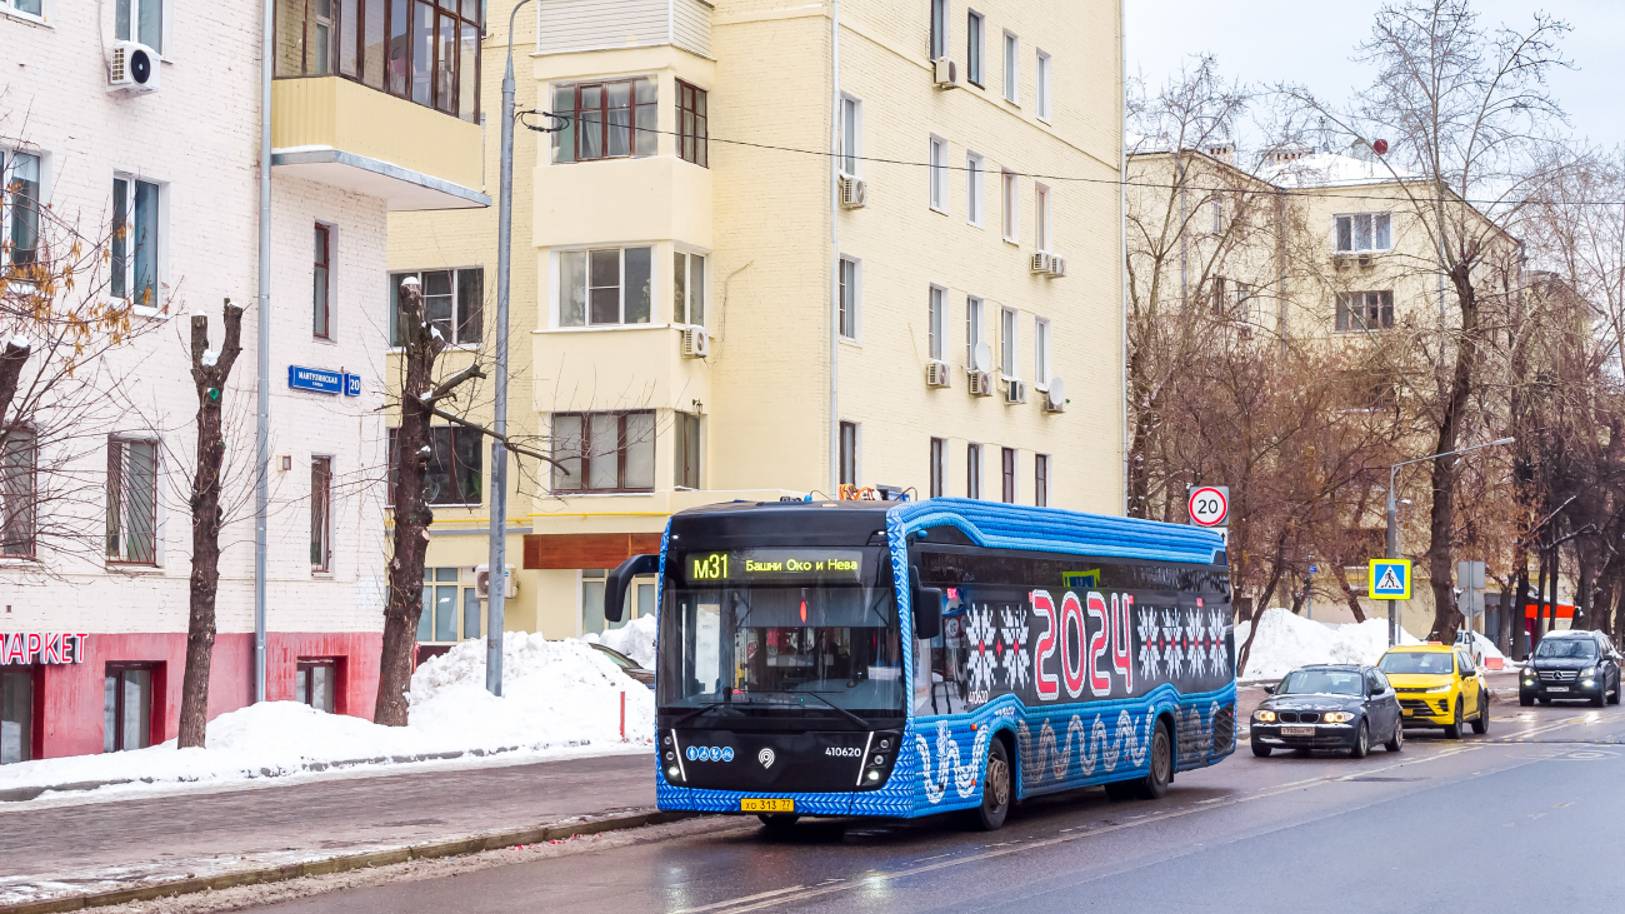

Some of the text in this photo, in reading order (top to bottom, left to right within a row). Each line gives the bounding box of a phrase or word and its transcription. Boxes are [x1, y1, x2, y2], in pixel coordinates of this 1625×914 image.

[350, 379, 360, 391] 20
[1198, 499, 1218, 514] 20
[694, 554, 728, 579] М31
[746, 559, 858, 572] Башни Око и Нева
[0, 632, 89, 665] АРКЕТ
[1032, 589, 1133, 701] 2024
[825, 747, 861, 757] 410620
[760, 800, 777, 810] 313
